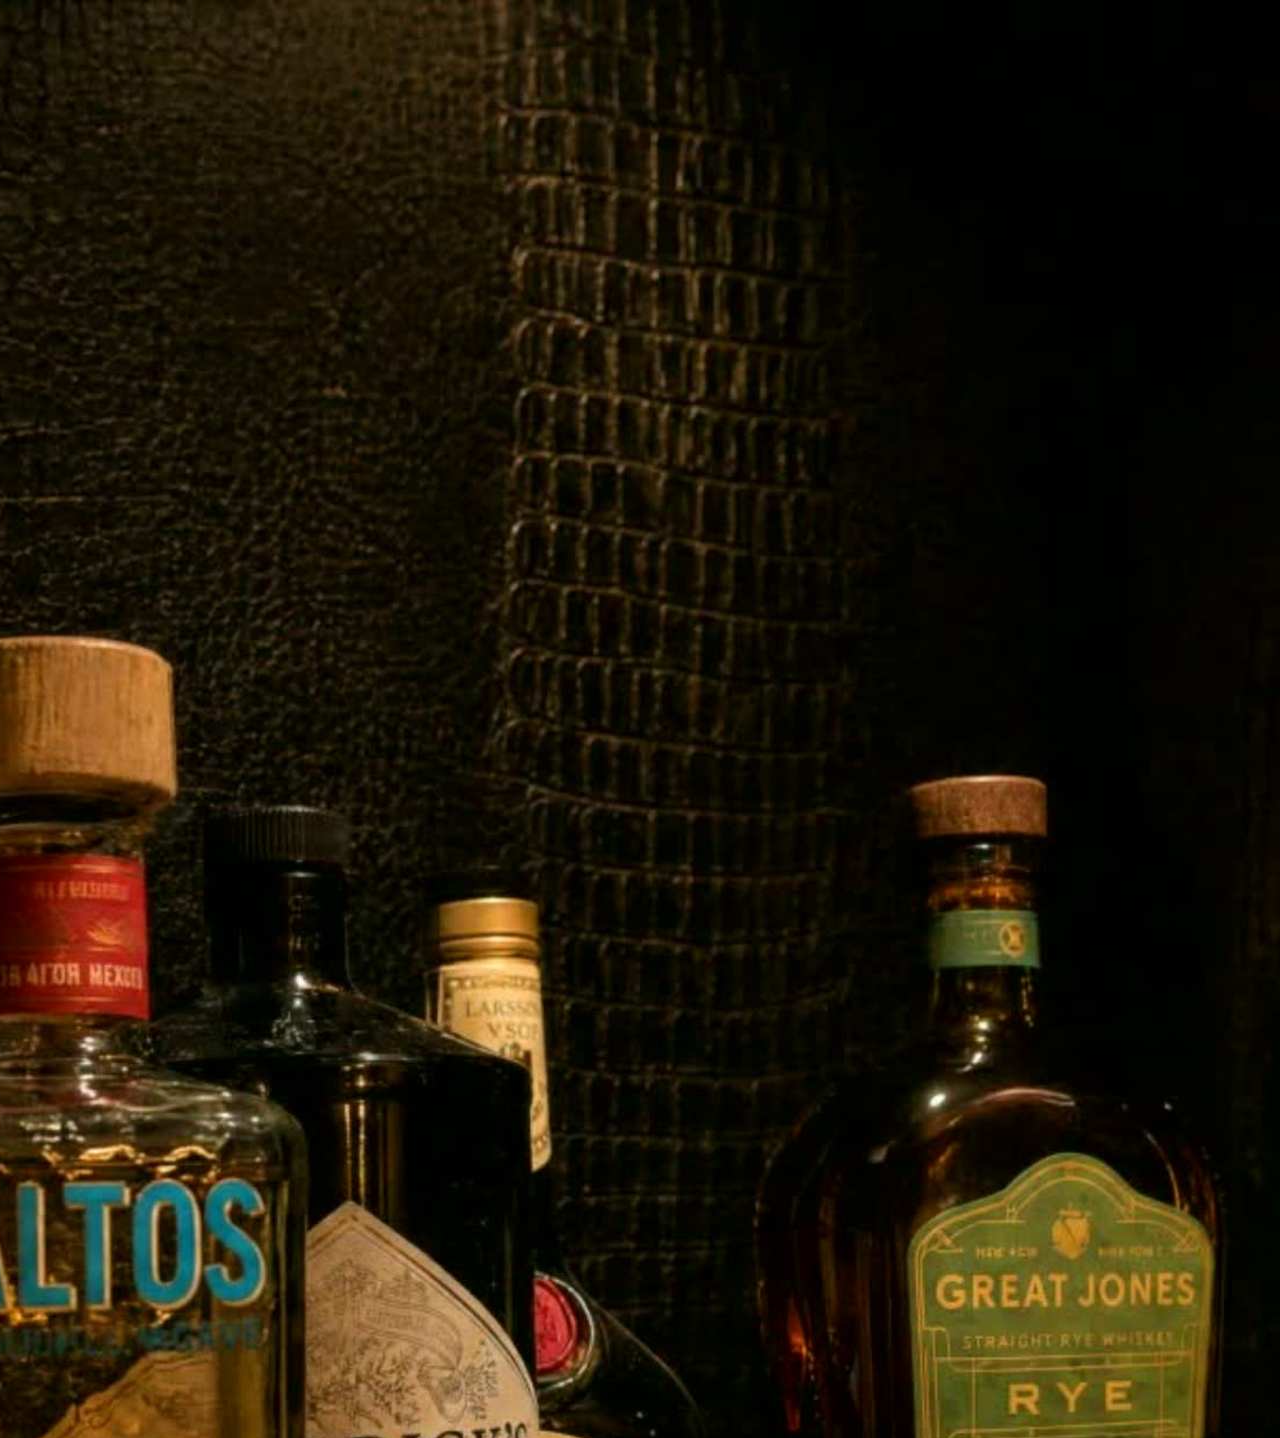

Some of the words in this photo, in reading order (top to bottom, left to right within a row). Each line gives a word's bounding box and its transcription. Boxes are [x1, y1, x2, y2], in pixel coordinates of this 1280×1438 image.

[935, 1273, 1067, 1309] GREAT
[1077, 1272, 1196, 1307] JONES
[962, 1333, 1052, 1351] STRAIGHT
[1060, 1332, 1094, 1348] RYE
[1007, 1379, 1134, 1416] RYE
